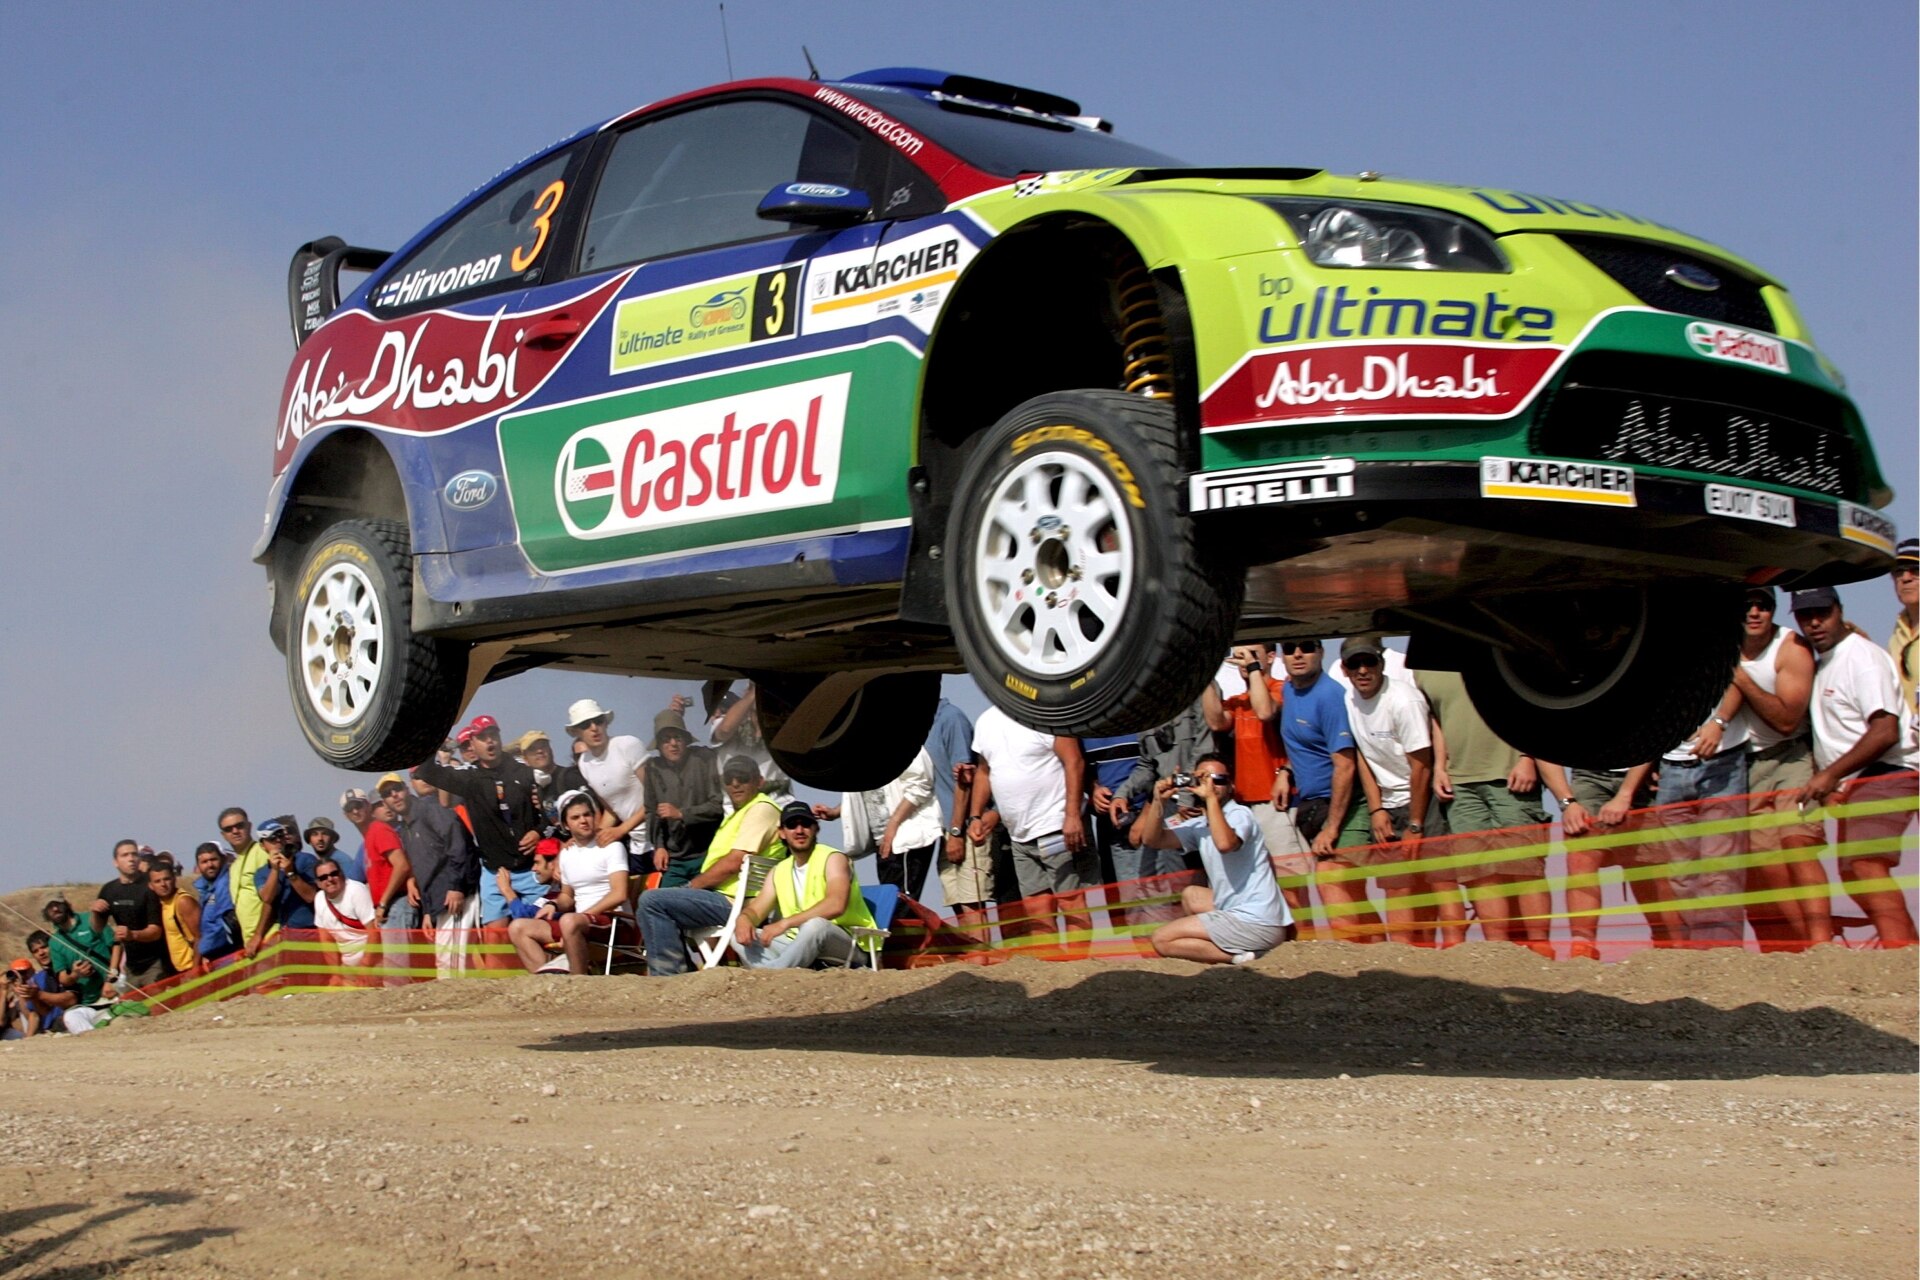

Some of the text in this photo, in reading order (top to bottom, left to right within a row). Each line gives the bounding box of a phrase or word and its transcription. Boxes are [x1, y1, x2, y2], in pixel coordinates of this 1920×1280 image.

[814, 87, 924, 156] www.wrcford.com
[511, 180, 565, 272] 3
[394, 254, 502, 307] Hirvonen
[834, 238, 959, 296] KÄRCHER
[1258, 273, 1293, 299] bp
[765, 272, 786, 335] 3
[1258, 286, 1555, 344] ultimate
[619, 326, 683, 355] ultimate
[275, 304, 524, 451] Abu Dhabi
[1255, 352, 1510, 409] Abu Dhabi
[620, 393, 823, 519] Castrol
[1189, 457, 1356, 512] PIRELLI
[452, 473, 488, 504] Ford
